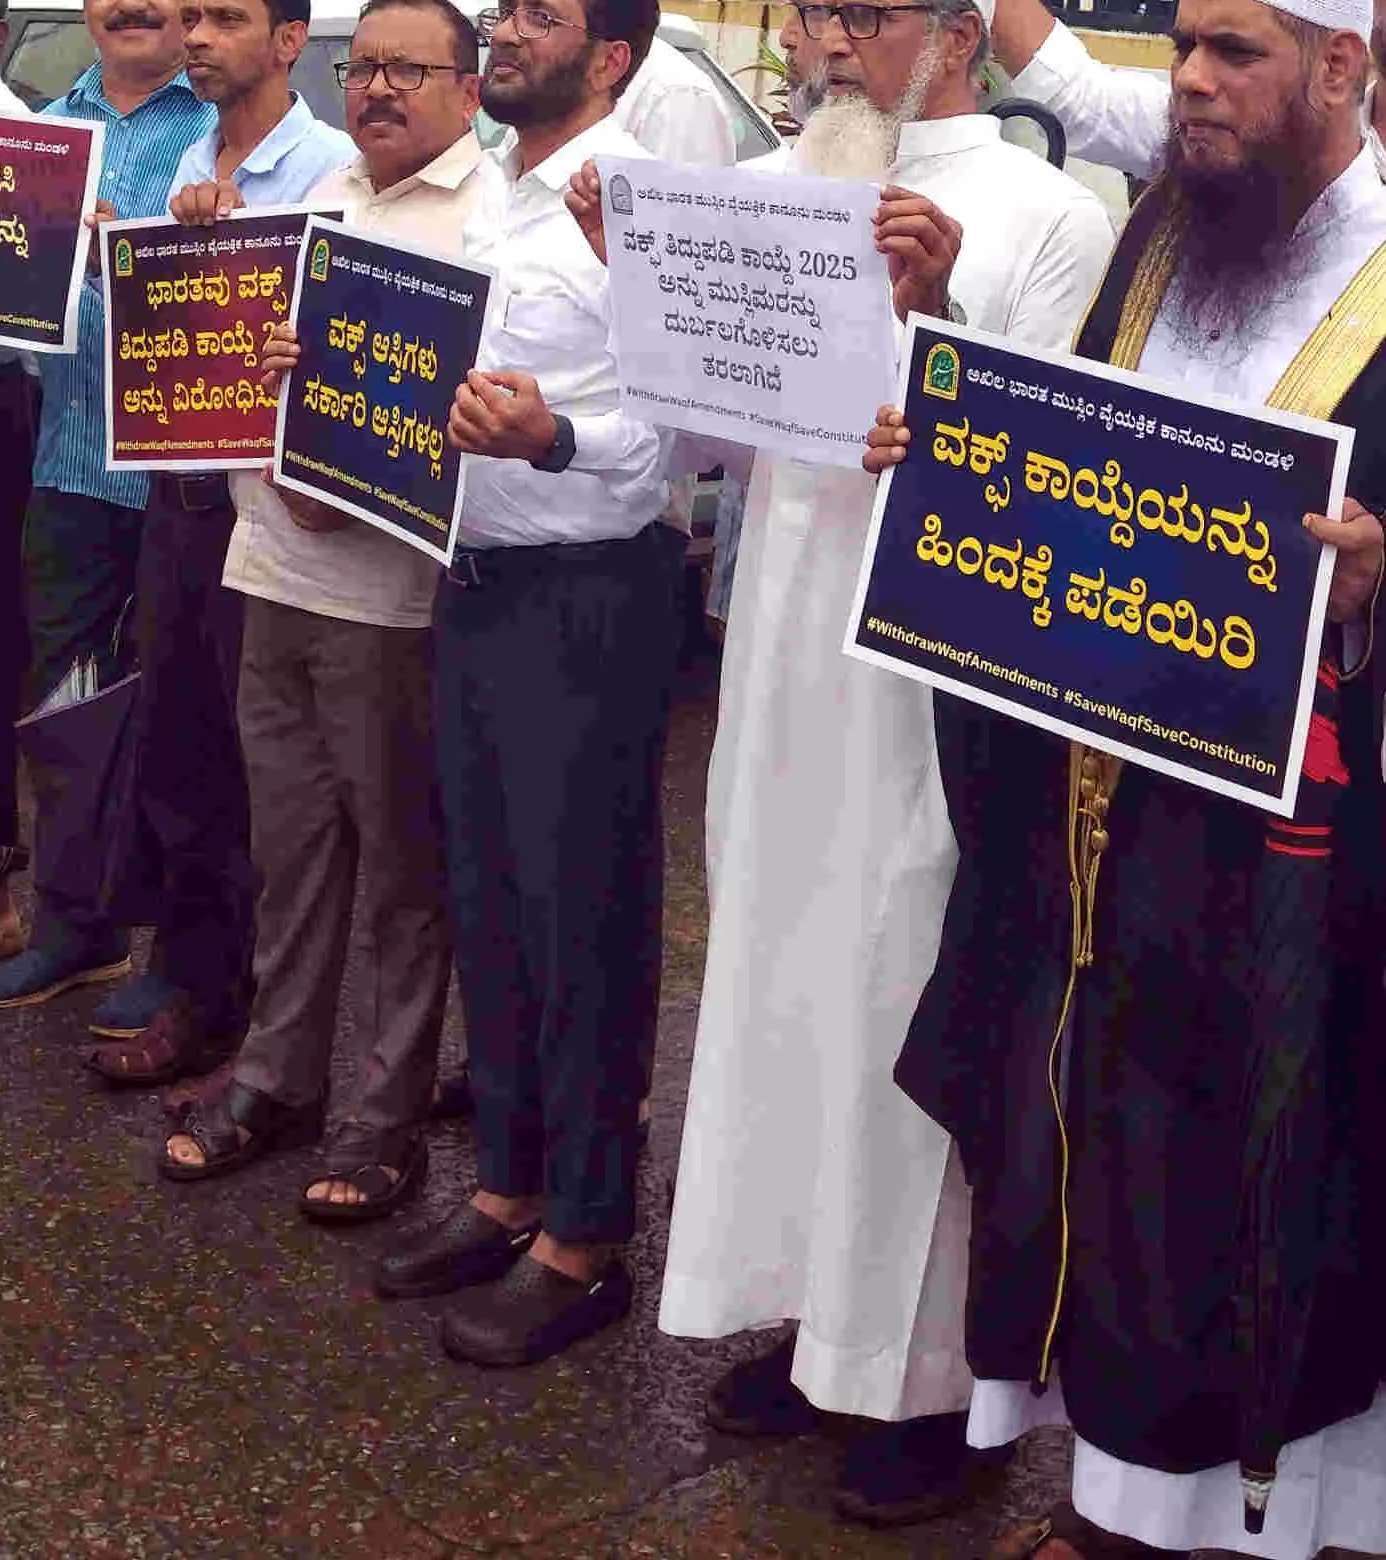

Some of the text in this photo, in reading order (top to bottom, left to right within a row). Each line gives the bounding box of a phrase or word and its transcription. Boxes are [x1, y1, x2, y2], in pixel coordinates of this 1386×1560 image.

[665, 233, 735, 271] ತಿದ್ದುಪಡಿ
[740, 245, 795, 286] ಕಾಯ್ದೆ
[798, 249, 859, 281] 2025
[146, 268, 231, 311] ಭಾರತವು
[658, 271, 822, 330] ಅನ್ನು ಮುಸ್ಲಿಮರನ್ನು
[118, 327, 190, 373] ತಿದ್ದುಪಡಿ
[195, 319, 257, 368] ಕಾಯ್ದೆ
[372, 329, 438, 385] ಆಸ್ತಿಗಳು
[664, 310, 819, 358] ದುರ್ಬಲಗೊಳಿಸಲು
[701, 354, 783, 393] ತರಲಾಗಿದೆ
[123, 381, 170, 425] ಅನ್ನು
[303, 374, 444, 481] ಸರ್ಕಾರಿ ಆಸ್ತಿಗಳಲ್ಲ
[966, 365, 1295, 473] ಅಖಿಲ ಭಾರತ ಮುಸ್ಲಿಂ ವೈಯಕ್ತಿಕ ಕಾನೂನು ಮಂಡಳಿ
[932, 416, 1278, 591] ವಕ್ಫ್ ಕಾಯ್ದೆಯನ್ನು
[915, 512, 1256, 672] ಹಿಂದಕ್ಕೆ ಪಡೆಯಿರಿ
[866, 614, 1279, 778] #WithdrawWaqfAmendments #SaveWaqfSaveConstitution
